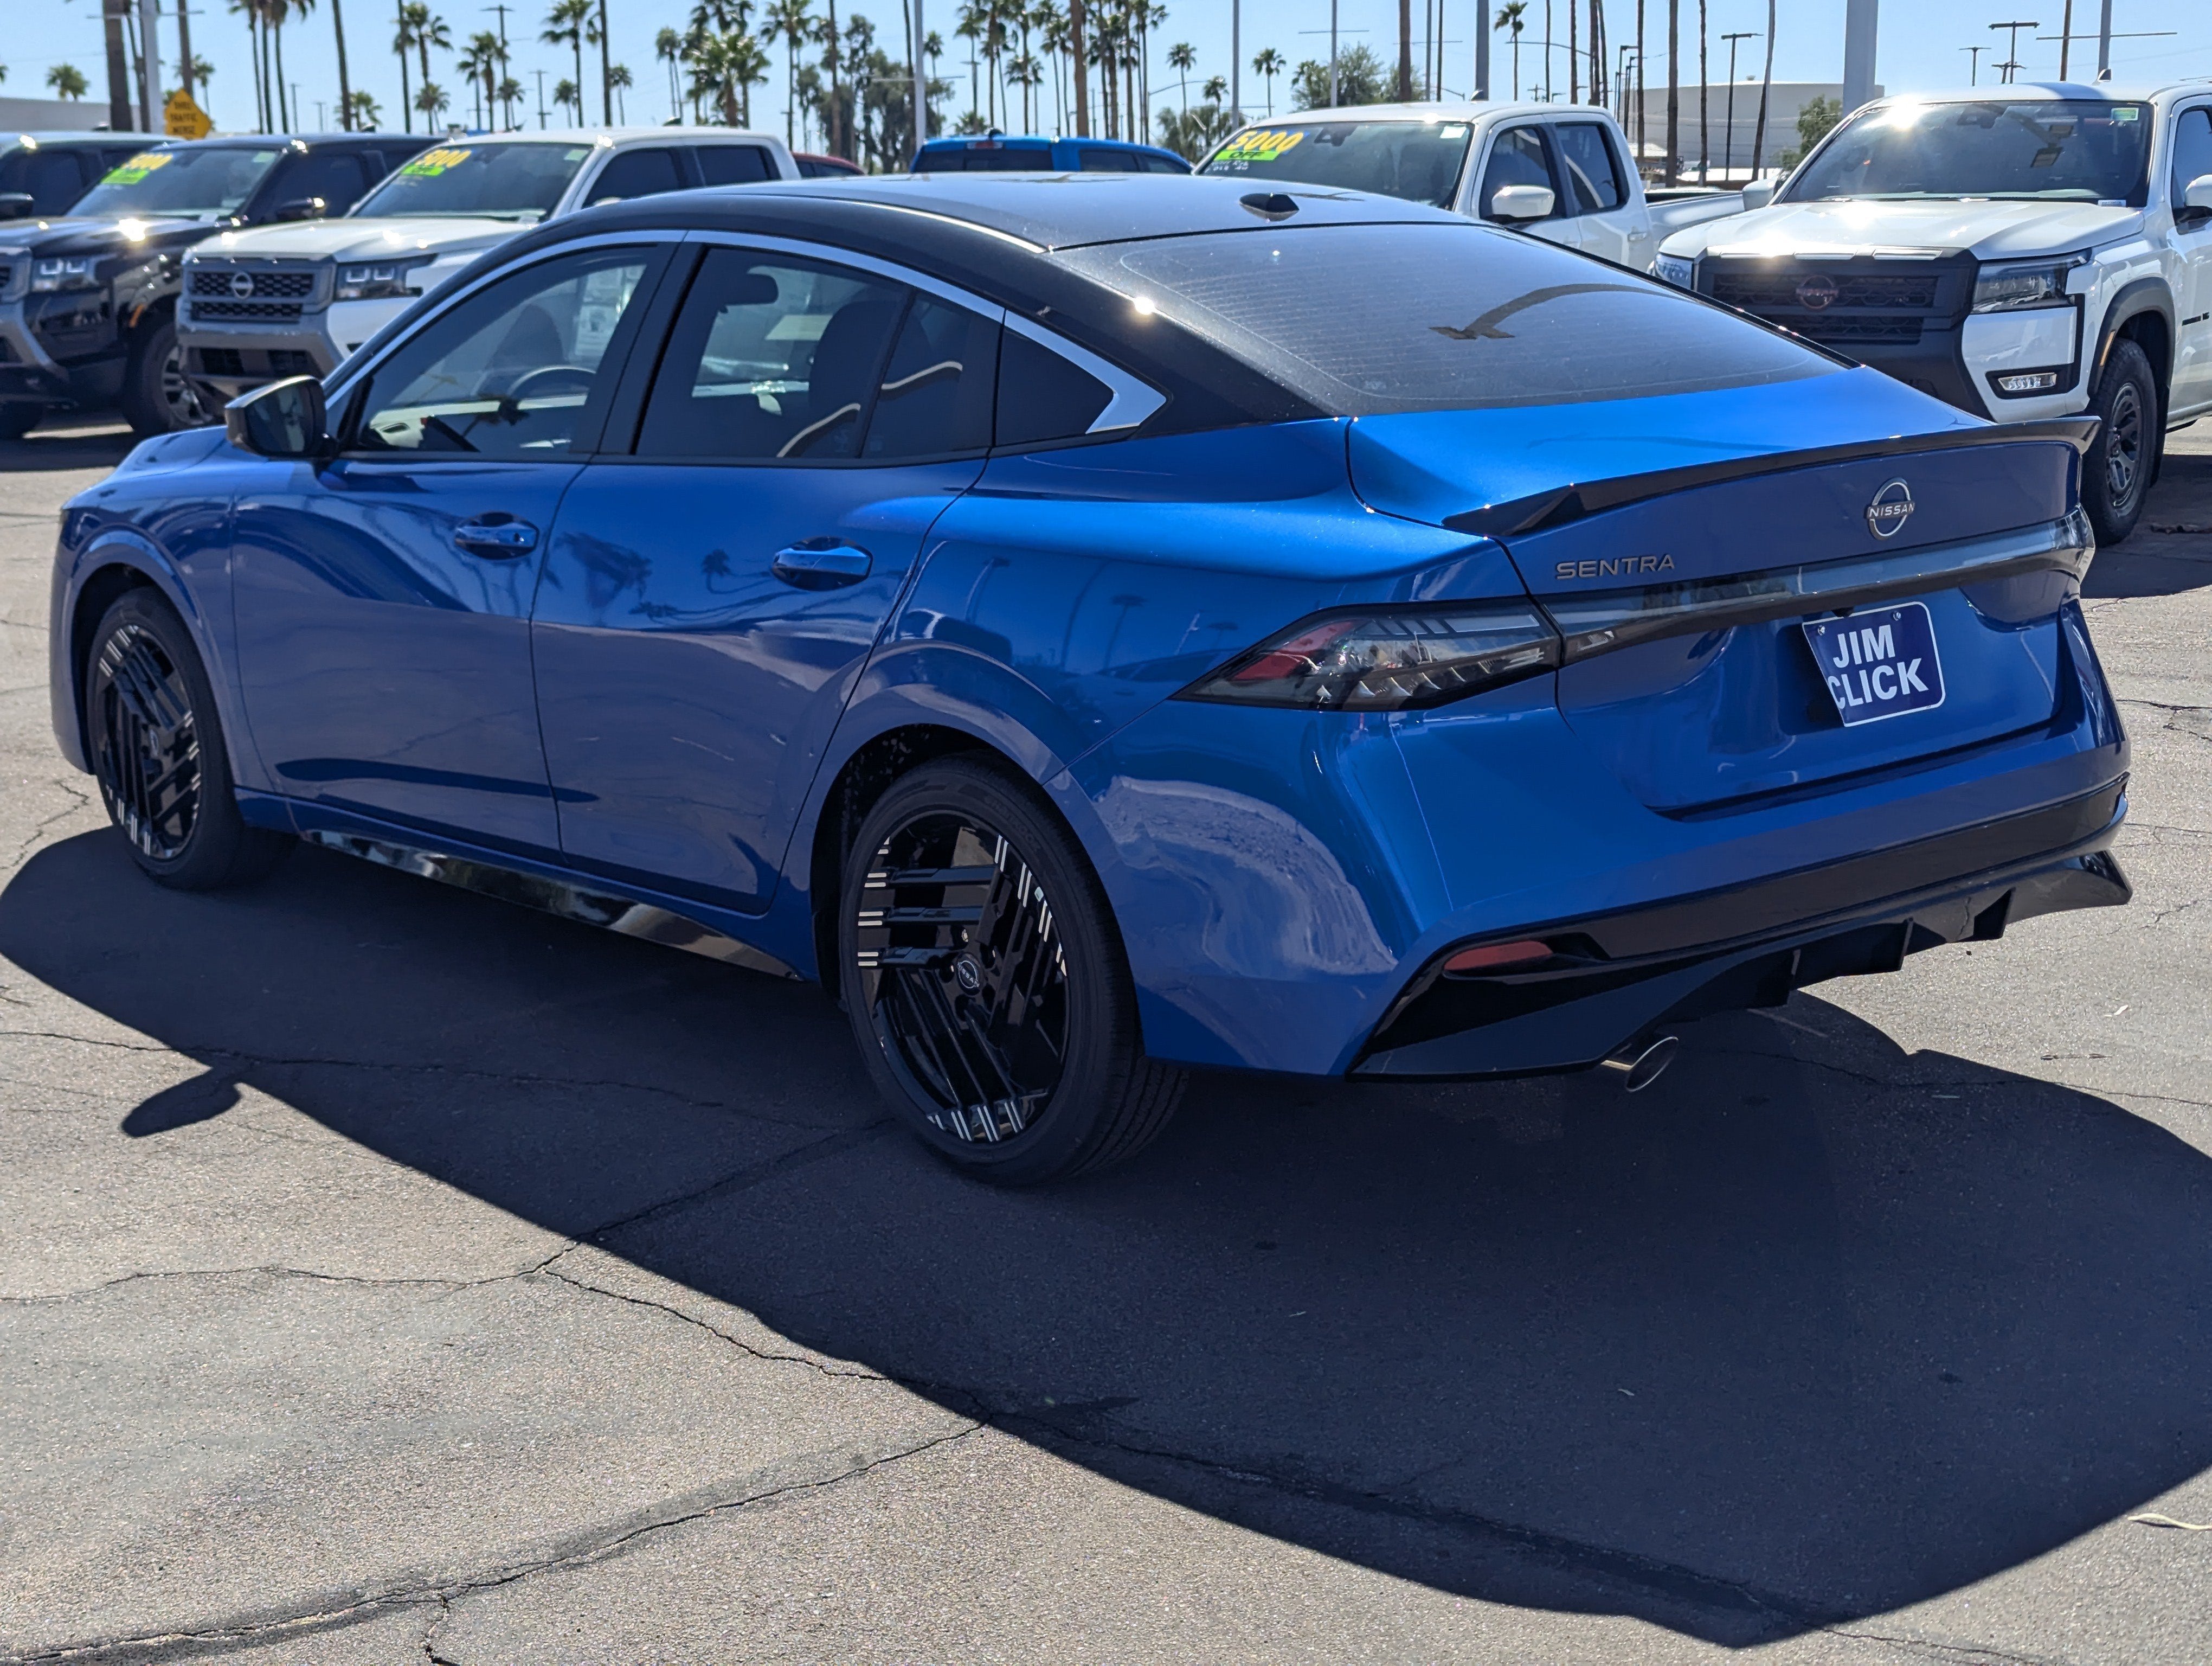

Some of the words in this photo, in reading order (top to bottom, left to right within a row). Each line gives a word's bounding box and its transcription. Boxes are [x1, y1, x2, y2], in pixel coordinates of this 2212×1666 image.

[1226, 130, 1304, 153] 5000
[1869, 503, 1915, 517] NISSAN
[1557, 554, 1675, 579] SENTRA
[1832, 624, 1895, 668] JIM
[1828, 657, 1928, 709] CLICK
